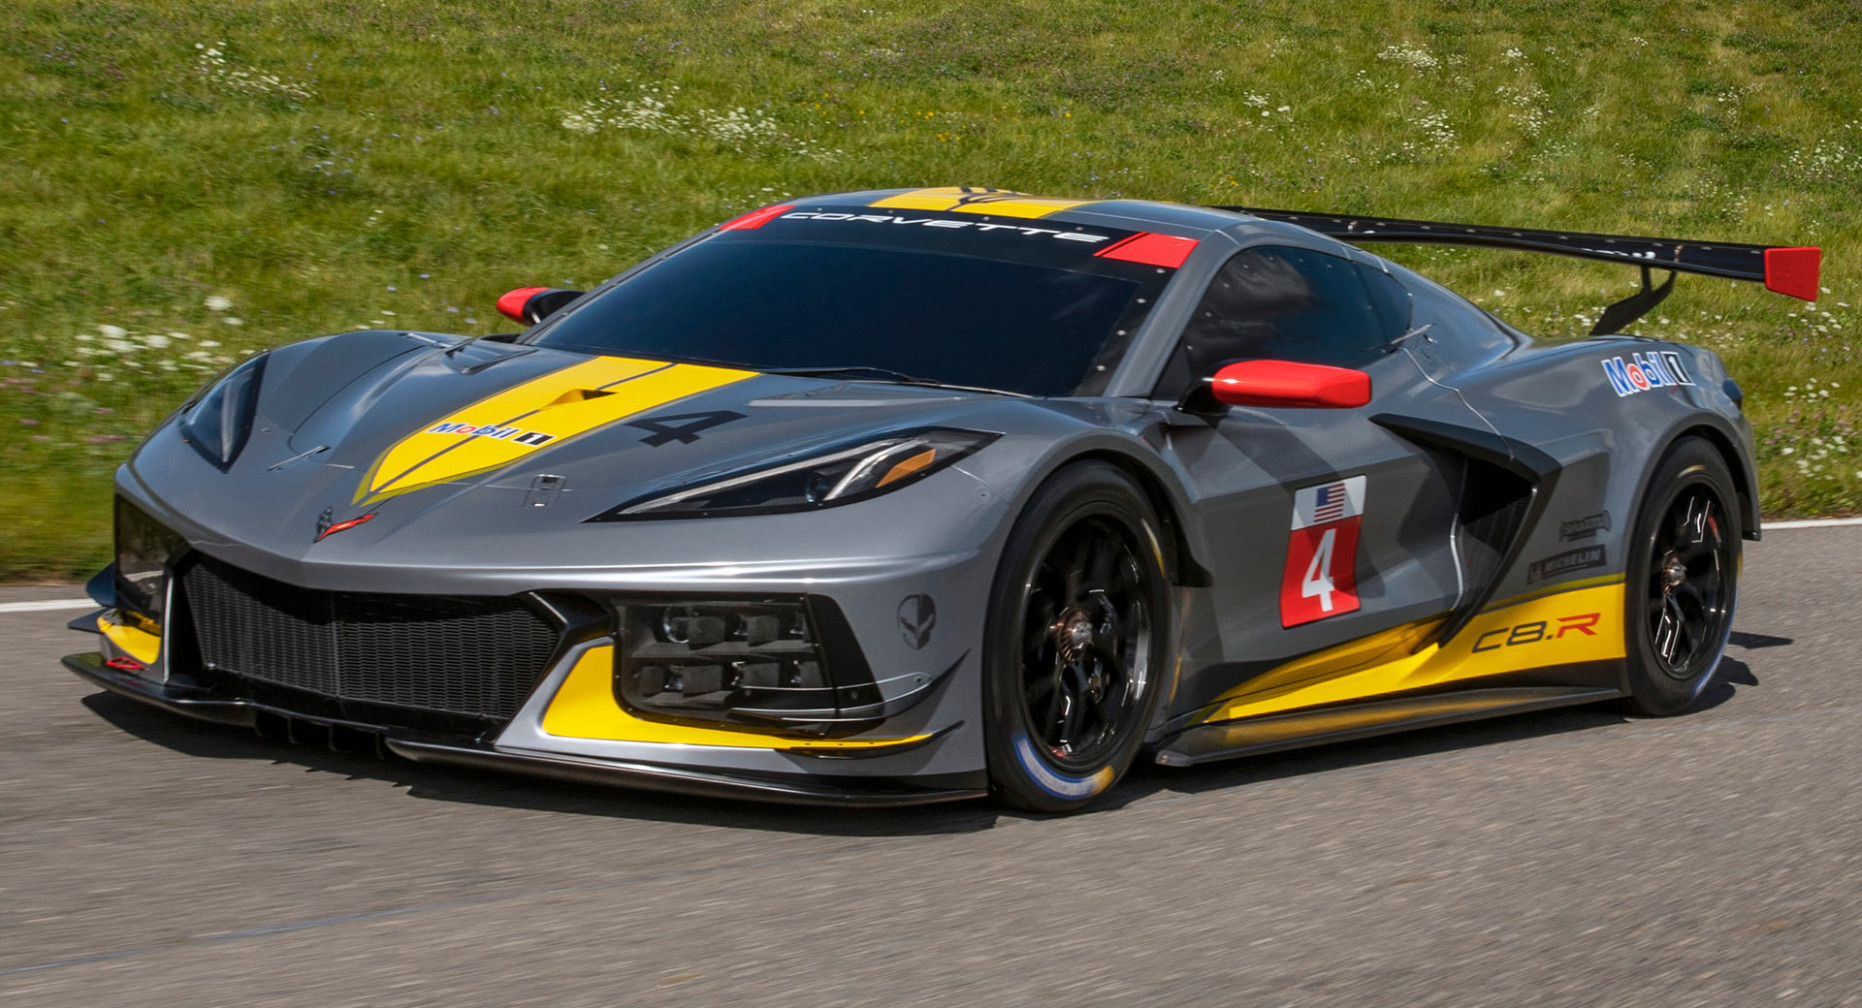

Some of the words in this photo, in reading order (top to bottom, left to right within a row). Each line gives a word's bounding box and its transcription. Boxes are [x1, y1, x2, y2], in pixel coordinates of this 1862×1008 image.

[780, 211, 1110, 243] CORVETTE
[1602, 353, 1677, 396] Mobil
[427, 422, 521, 439] Mobil
[623, 409, 748, 447] 4
[1302, 528, 1336, 612] 4
[1543, 549, 1602, 573] MICHELIN
[1471, 612, 1600, 653] C8.R
